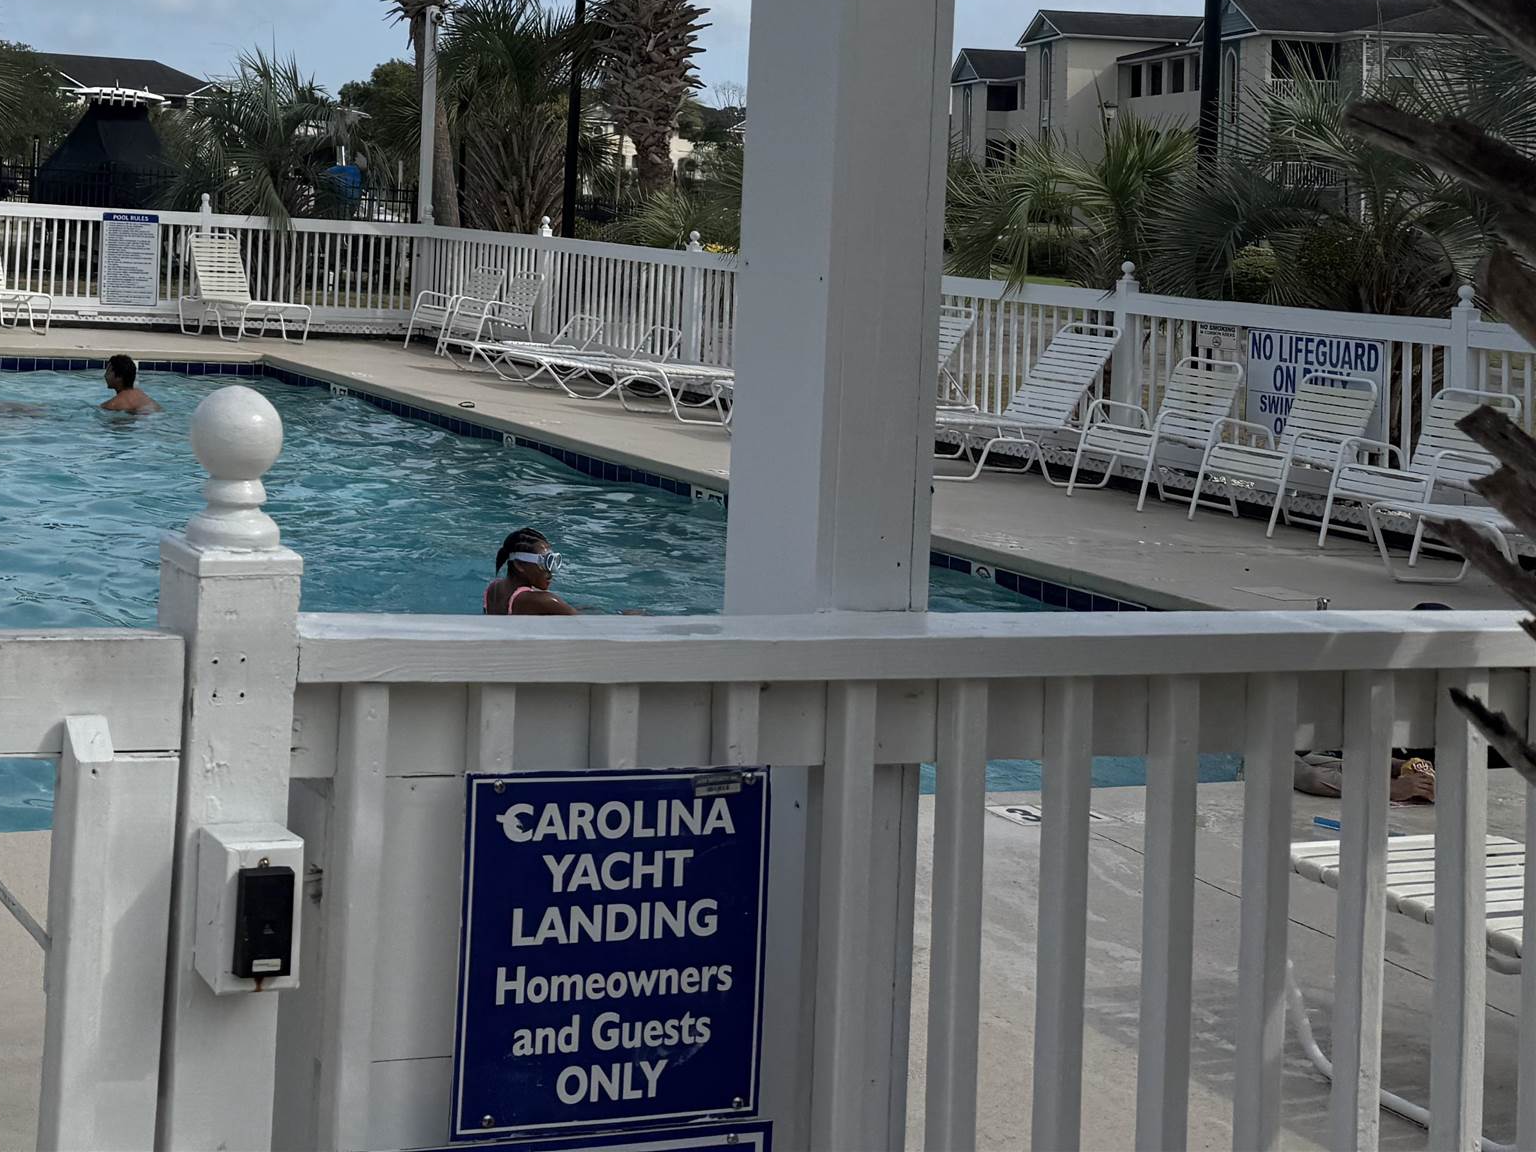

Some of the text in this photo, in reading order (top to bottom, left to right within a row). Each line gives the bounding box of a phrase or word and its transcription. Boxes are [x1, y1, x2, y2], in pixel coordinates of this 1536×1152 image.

[1251, 332, 1379, 372] NO LIFEGUARD
[1273, 365, 1296, 394] ON
[500, 797, 736, 843] CAROLINA
[542, 849, 694, 893] YACHT
[511, 898, 719, 947] LANDING
[494, 963, 733, 1006] Homeowners
[512, 1010, 712, 1057] and Guests
[556, 1059, 669, 1105] ONLY
